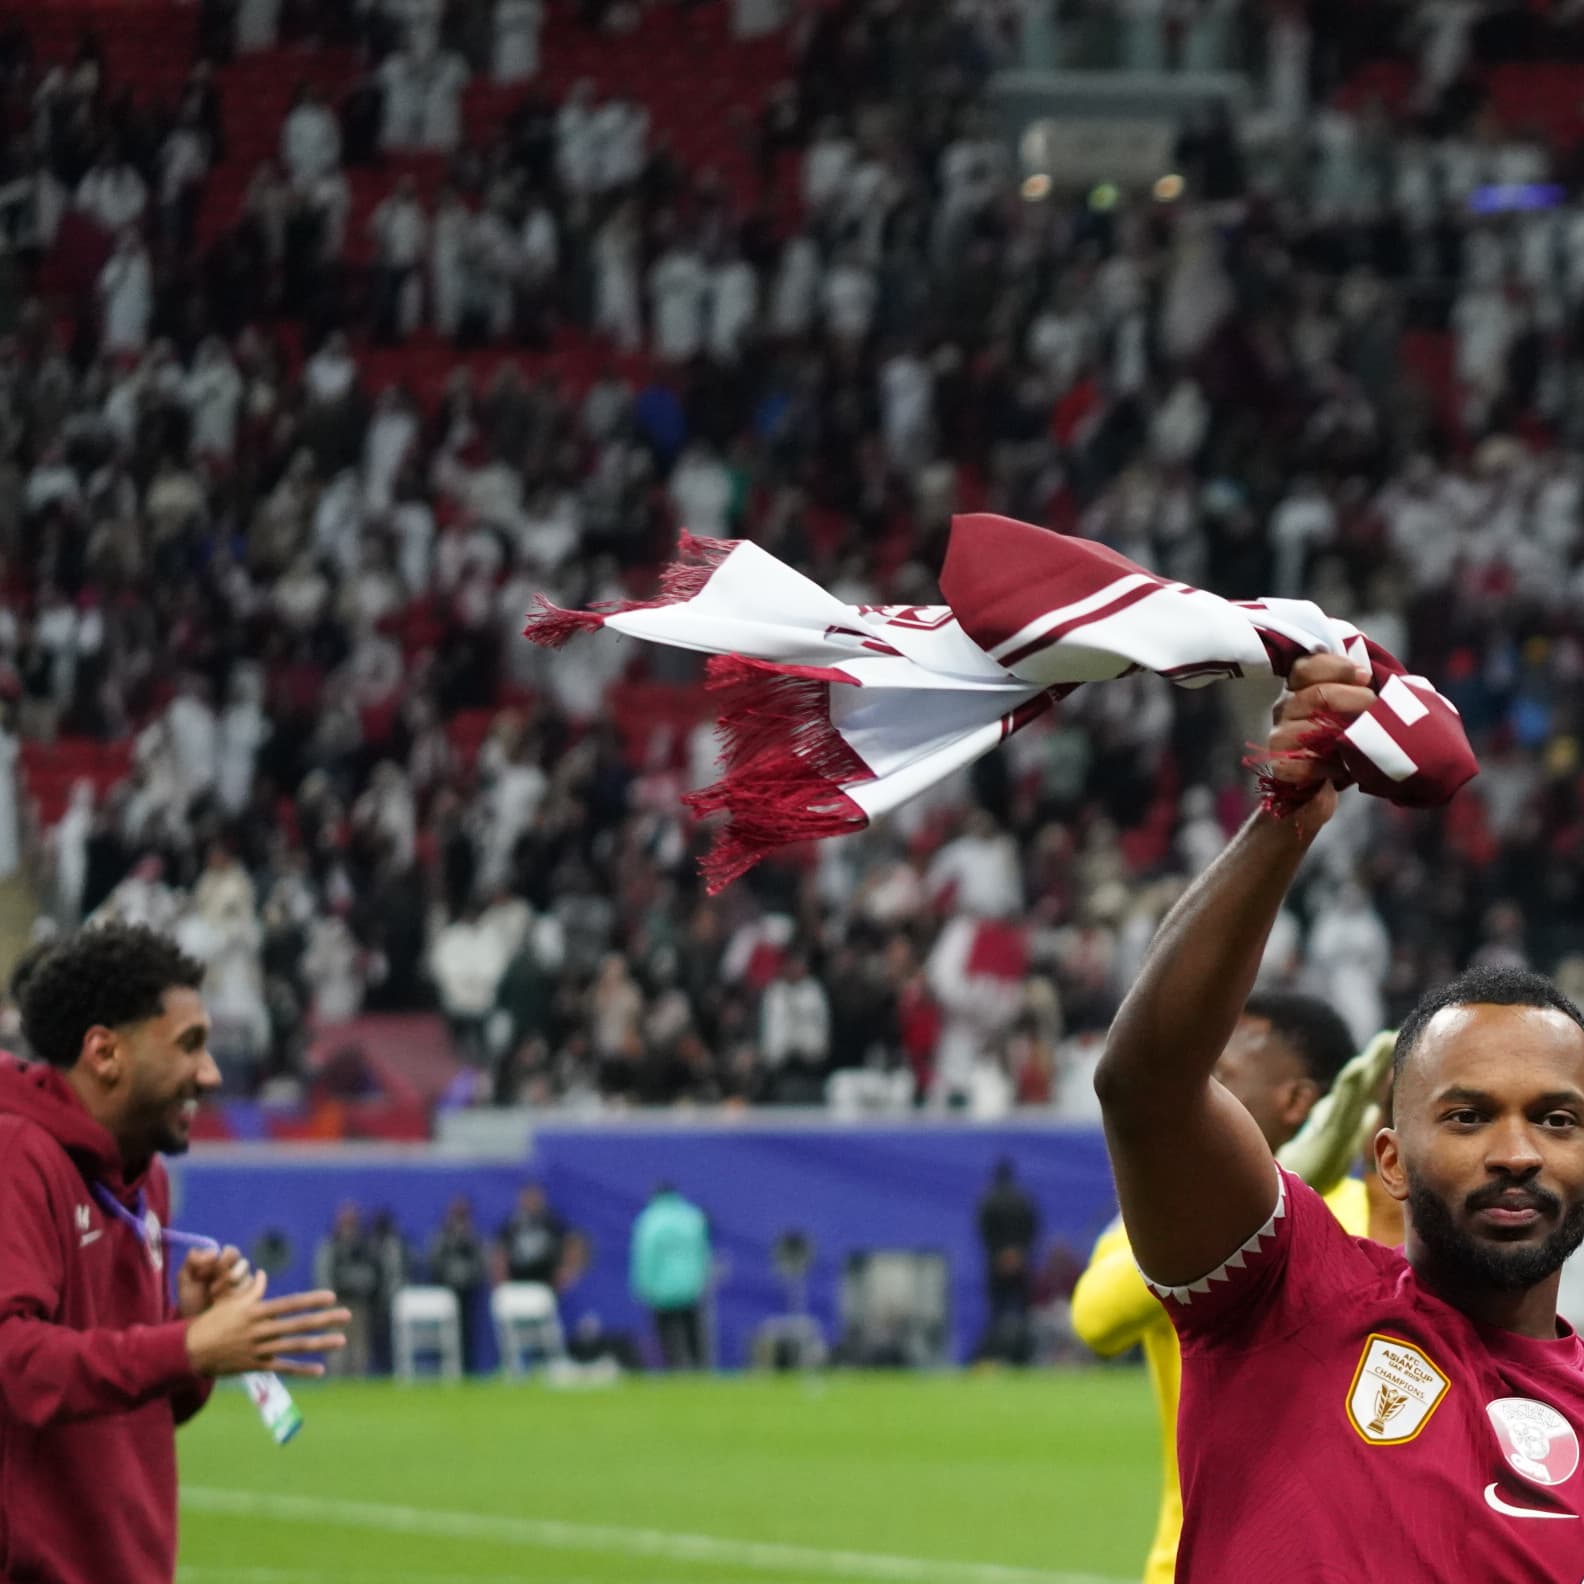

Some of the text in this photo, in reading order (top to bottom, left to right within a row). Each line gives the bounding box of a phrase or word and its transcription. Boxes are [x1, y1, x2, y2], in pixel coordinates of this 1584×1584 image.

[1382, 1349, 1434, 1383] ASIAN CUP
[1402, 1352, 1421, 1366] AFC
[1374, 1366, 1425, 1400] CHAMPIONS
